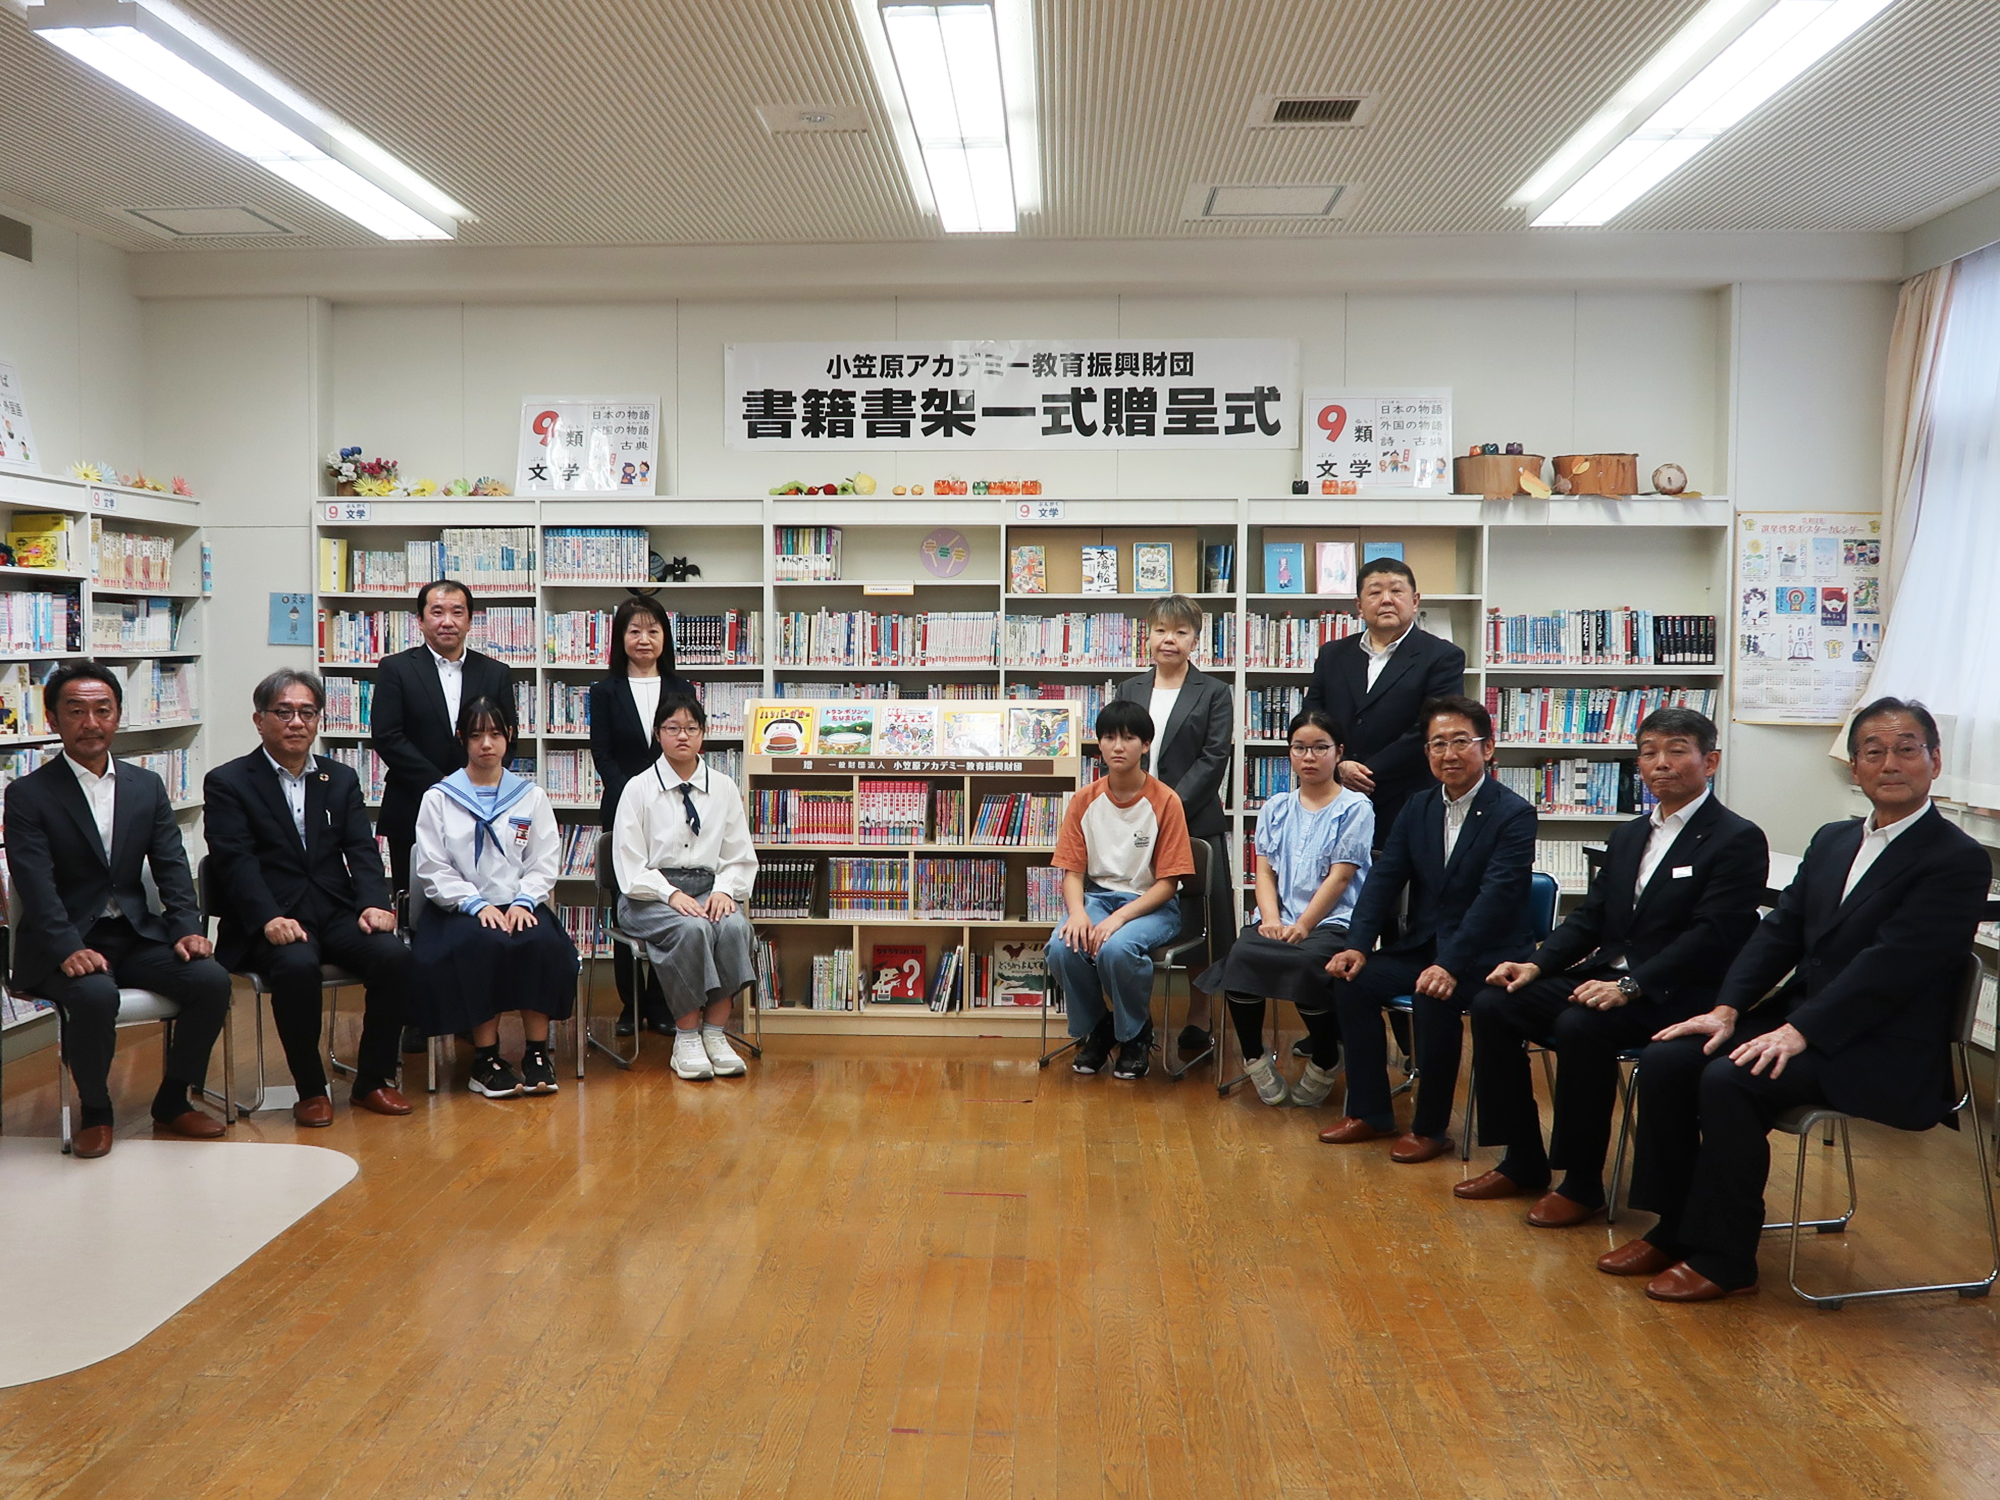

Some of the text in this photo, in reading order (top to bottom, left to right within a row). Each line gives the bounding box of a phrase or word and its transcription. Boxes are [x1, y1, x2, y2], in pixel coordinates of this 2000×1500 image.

[827, 352, 1194, 380] 小笠原アカデミー教育振興財団
[592, 410, 650, 420] 日本の物語
[741, 386, 1281, 439] 書籍書架一式贈呈式
[1381, 405, 1443, 414] 日本の物語
[1317, 404, 1374, 443] 9 類
[1380, 421, 1443, 431] 外国の物語
[566, 430, 583, 447] 類
[93, 492, 100, 507] 9
[328, 506, 366, 519] 9 文学
[1020, 504, 1059, 518] 9 文学
[828, 761, 886, 770] 一般財団法人
[893, 761, 1023, 772] 小笠原アカデミー教育振興財団
